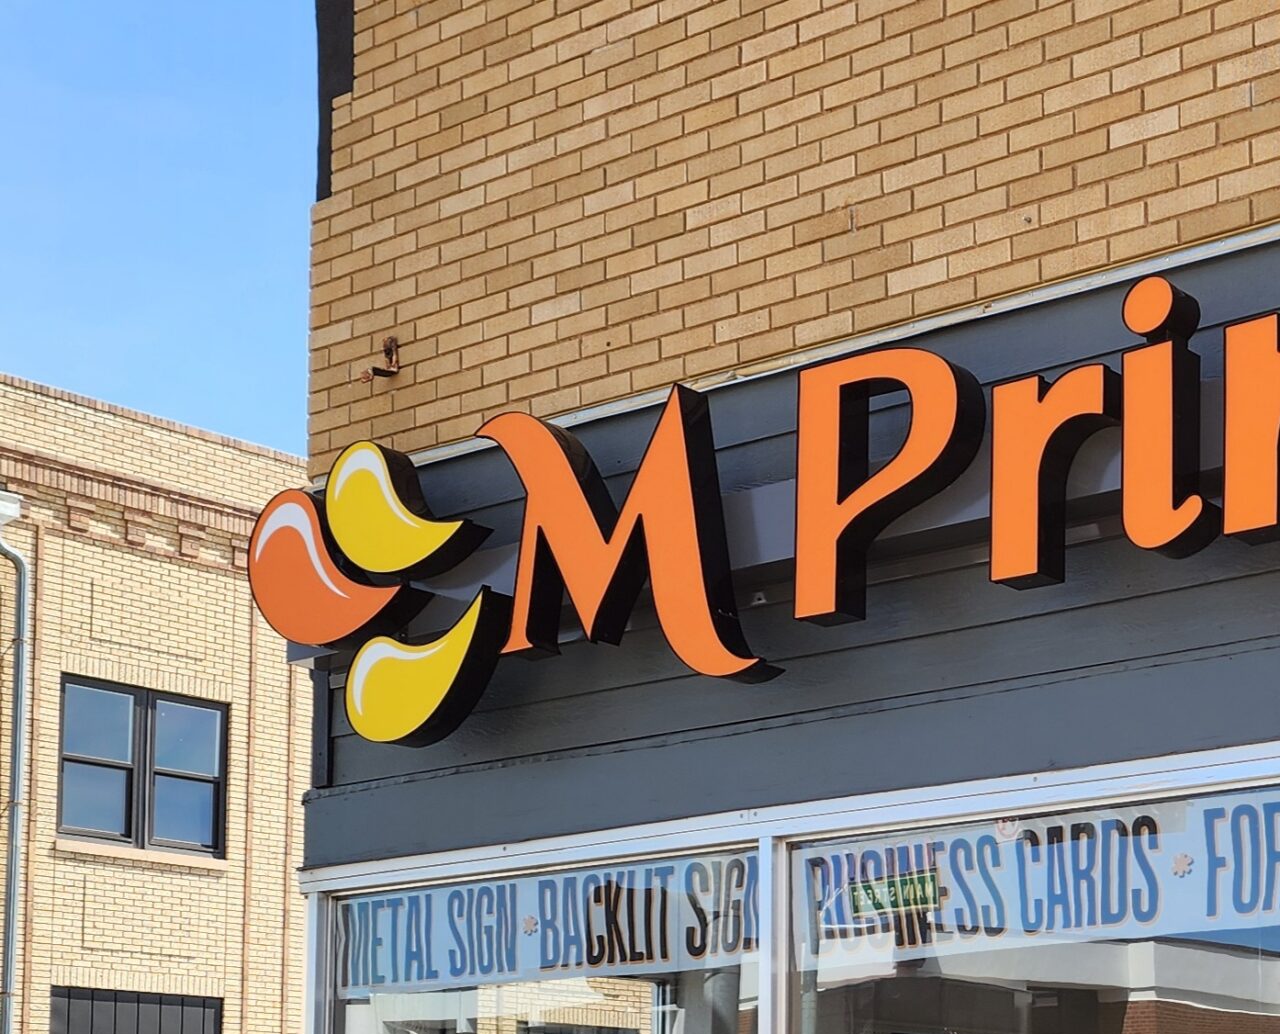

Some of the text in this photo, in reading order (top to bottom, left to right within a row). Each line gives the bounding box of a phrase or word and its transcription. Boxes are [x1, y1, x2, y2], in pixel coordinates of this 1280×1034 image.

[474, 383, 768, 678] M
[340, 889, 440, 988] METAL
[447, 882, 518, 978] SIGN
[537, 865, 675, 971] BACKLIT
[804, 834, 1006, 956] BUSINESS
[1018, 814, 1162, 934] CARDS
